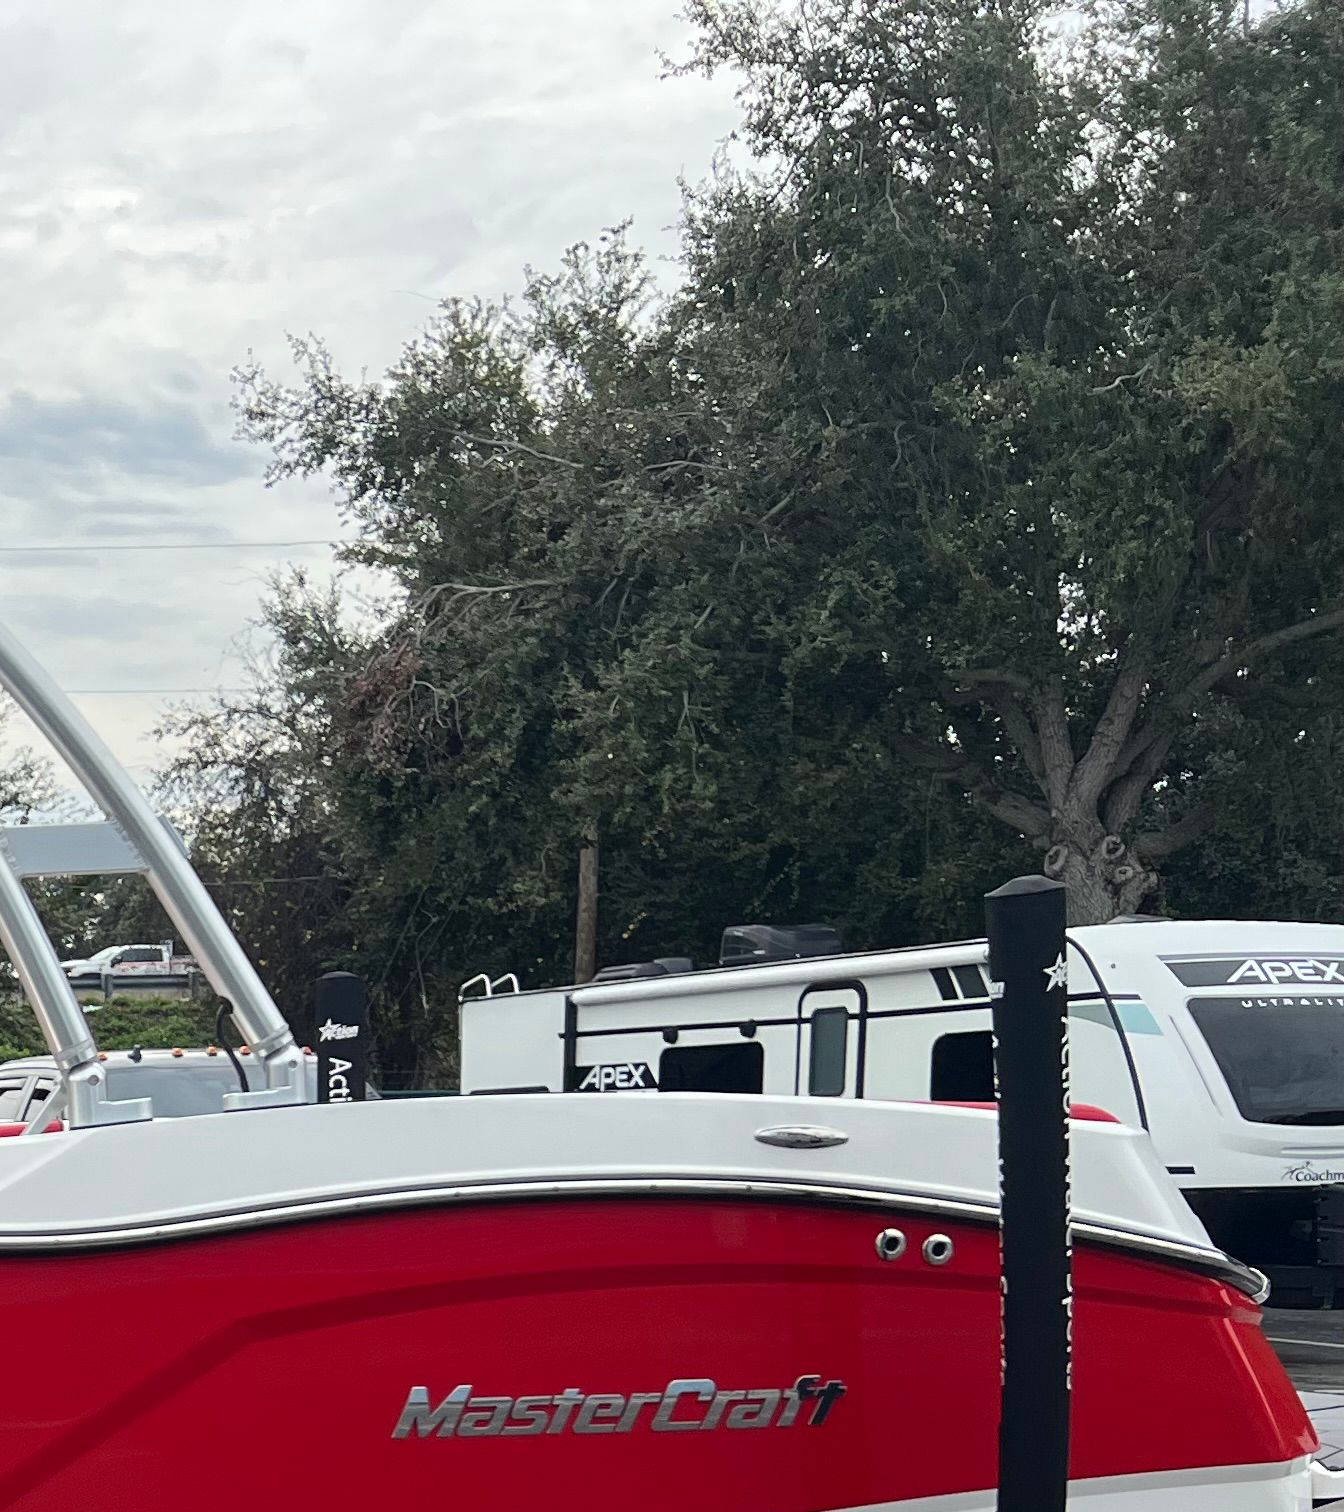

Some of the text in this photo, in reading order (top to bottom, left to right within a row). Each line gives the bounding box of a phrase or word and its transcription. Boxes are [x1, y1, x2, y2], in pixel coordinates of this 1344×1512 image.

[1227, 959, 1344, 985] APEX
[579, 1063, 646, 1092] APEX
[390, 1374, 848, 1439] MasterCraft
